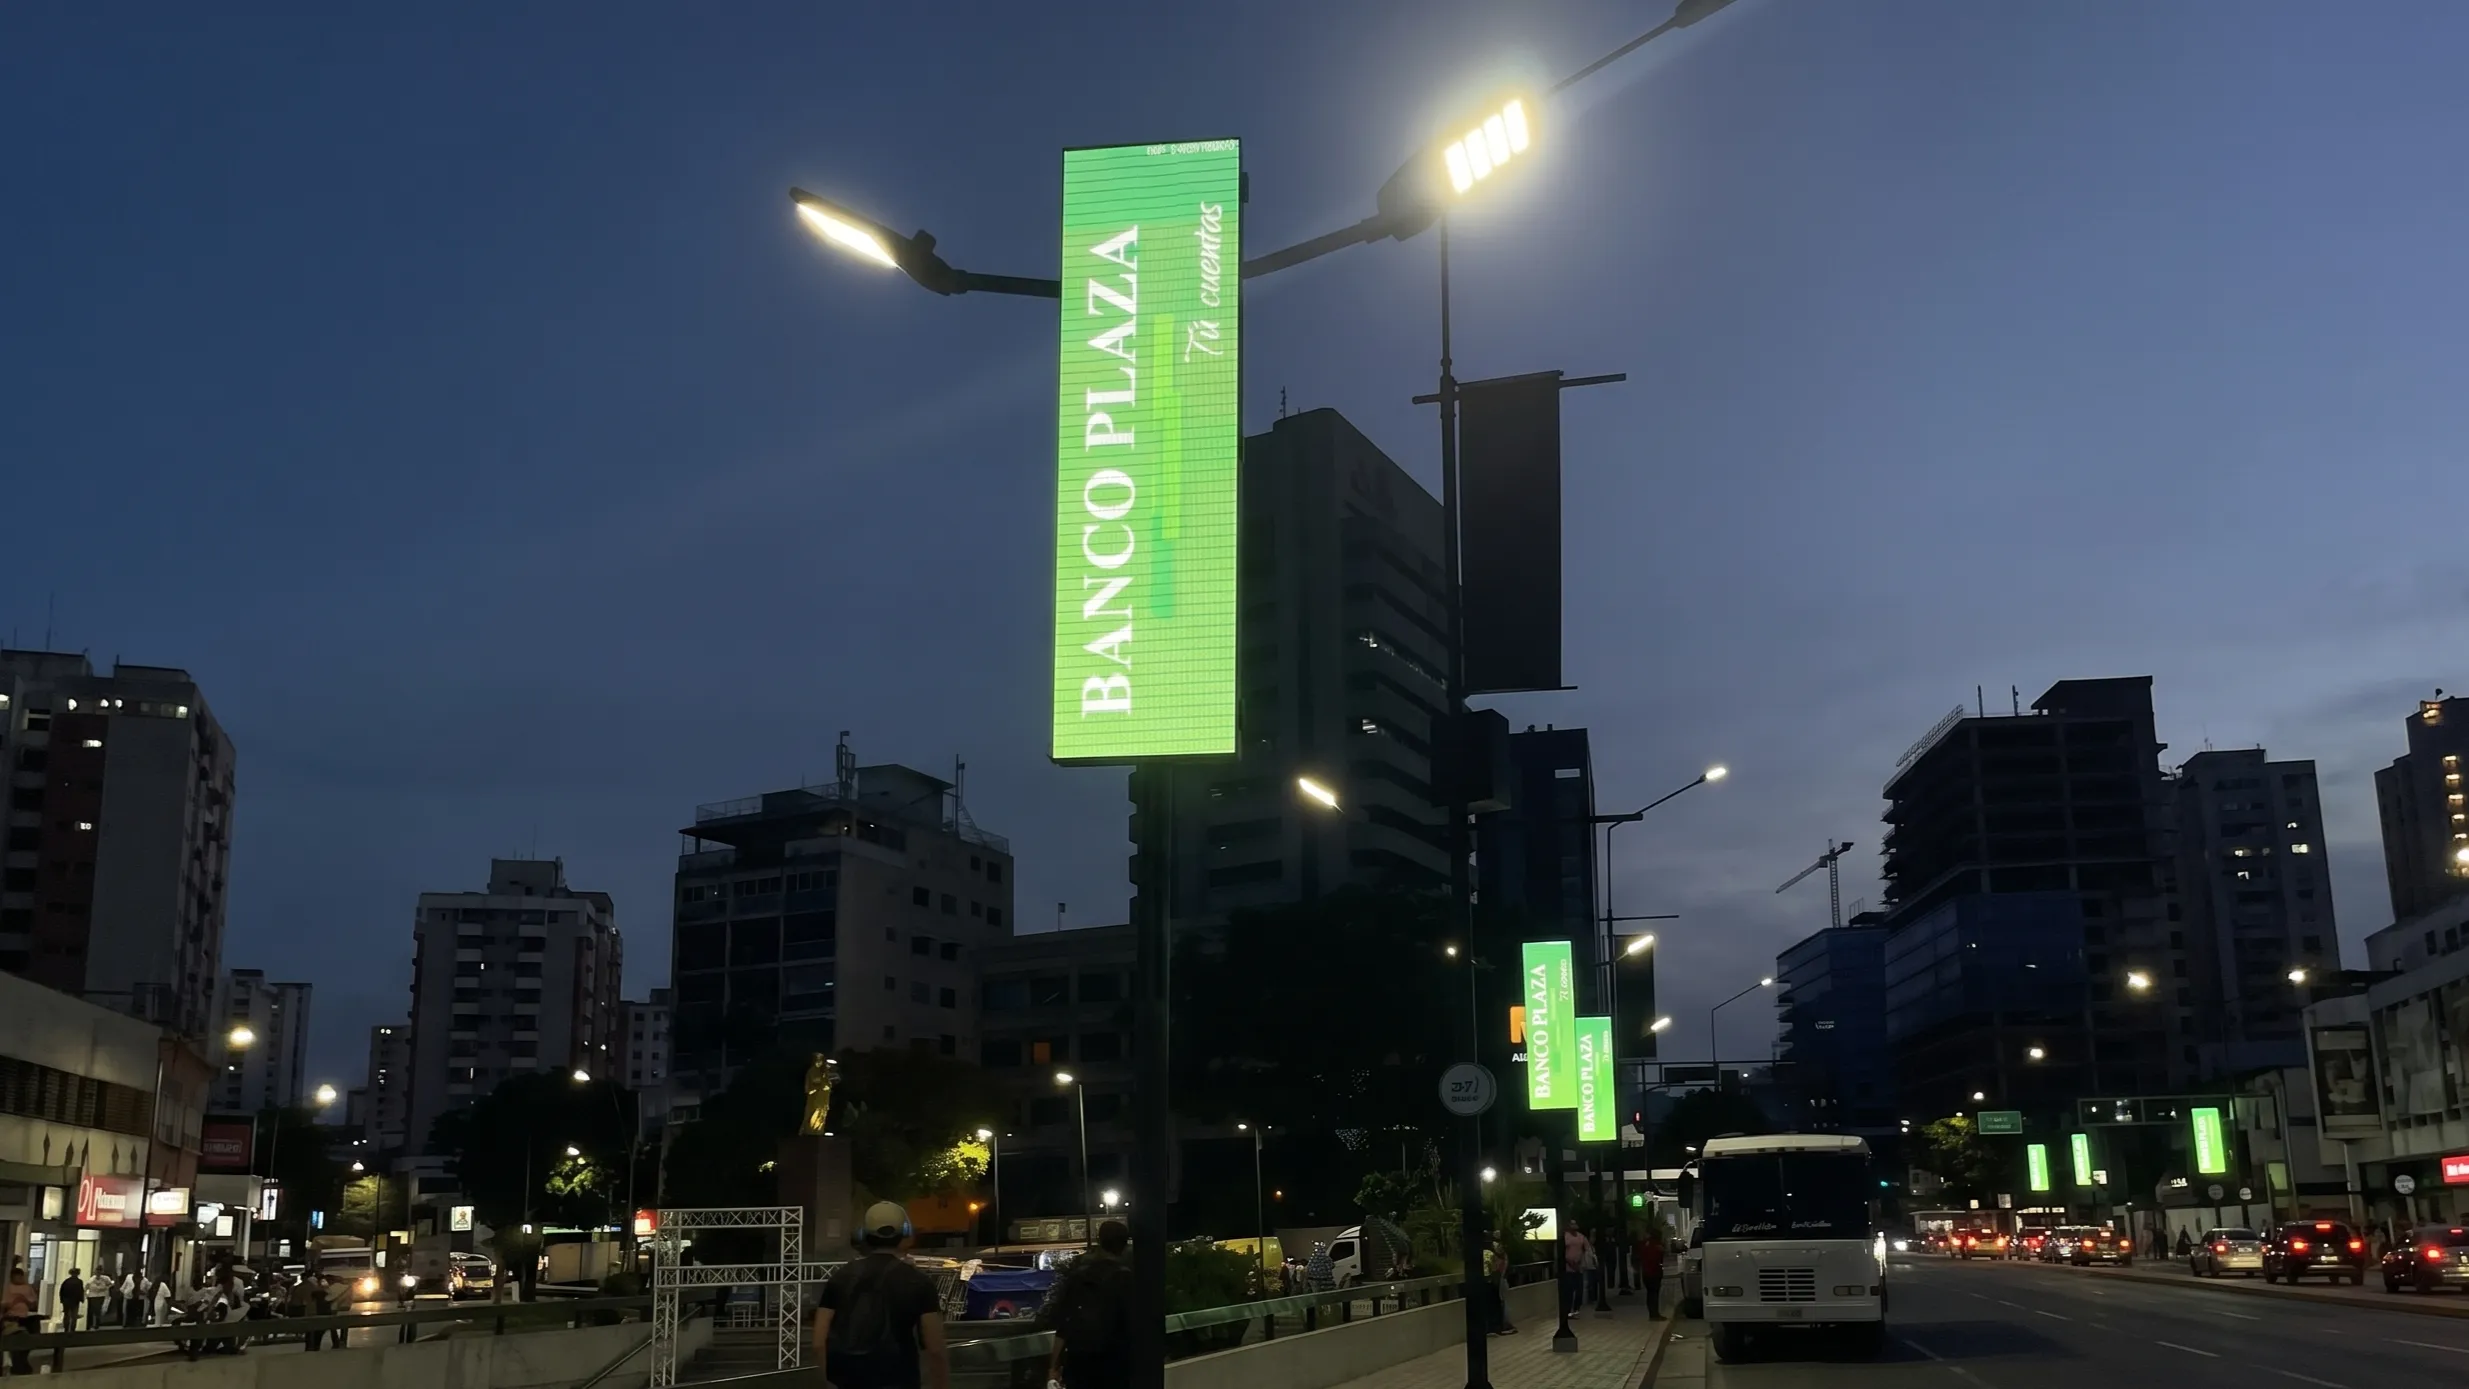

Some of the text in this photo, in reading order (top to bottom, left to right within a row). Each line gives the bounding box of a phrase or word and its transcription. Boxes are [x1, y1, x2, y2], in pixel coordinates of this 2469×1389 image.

[1184, 201, 1224, 363] Tú cuentas
[1082, 225, 1139, 719] BANCO PLAZA
[1530, 964, 1551, 1098] BANCO PLAZA
[1580, 1033, 1595, 1132] BANCO PLAZA
